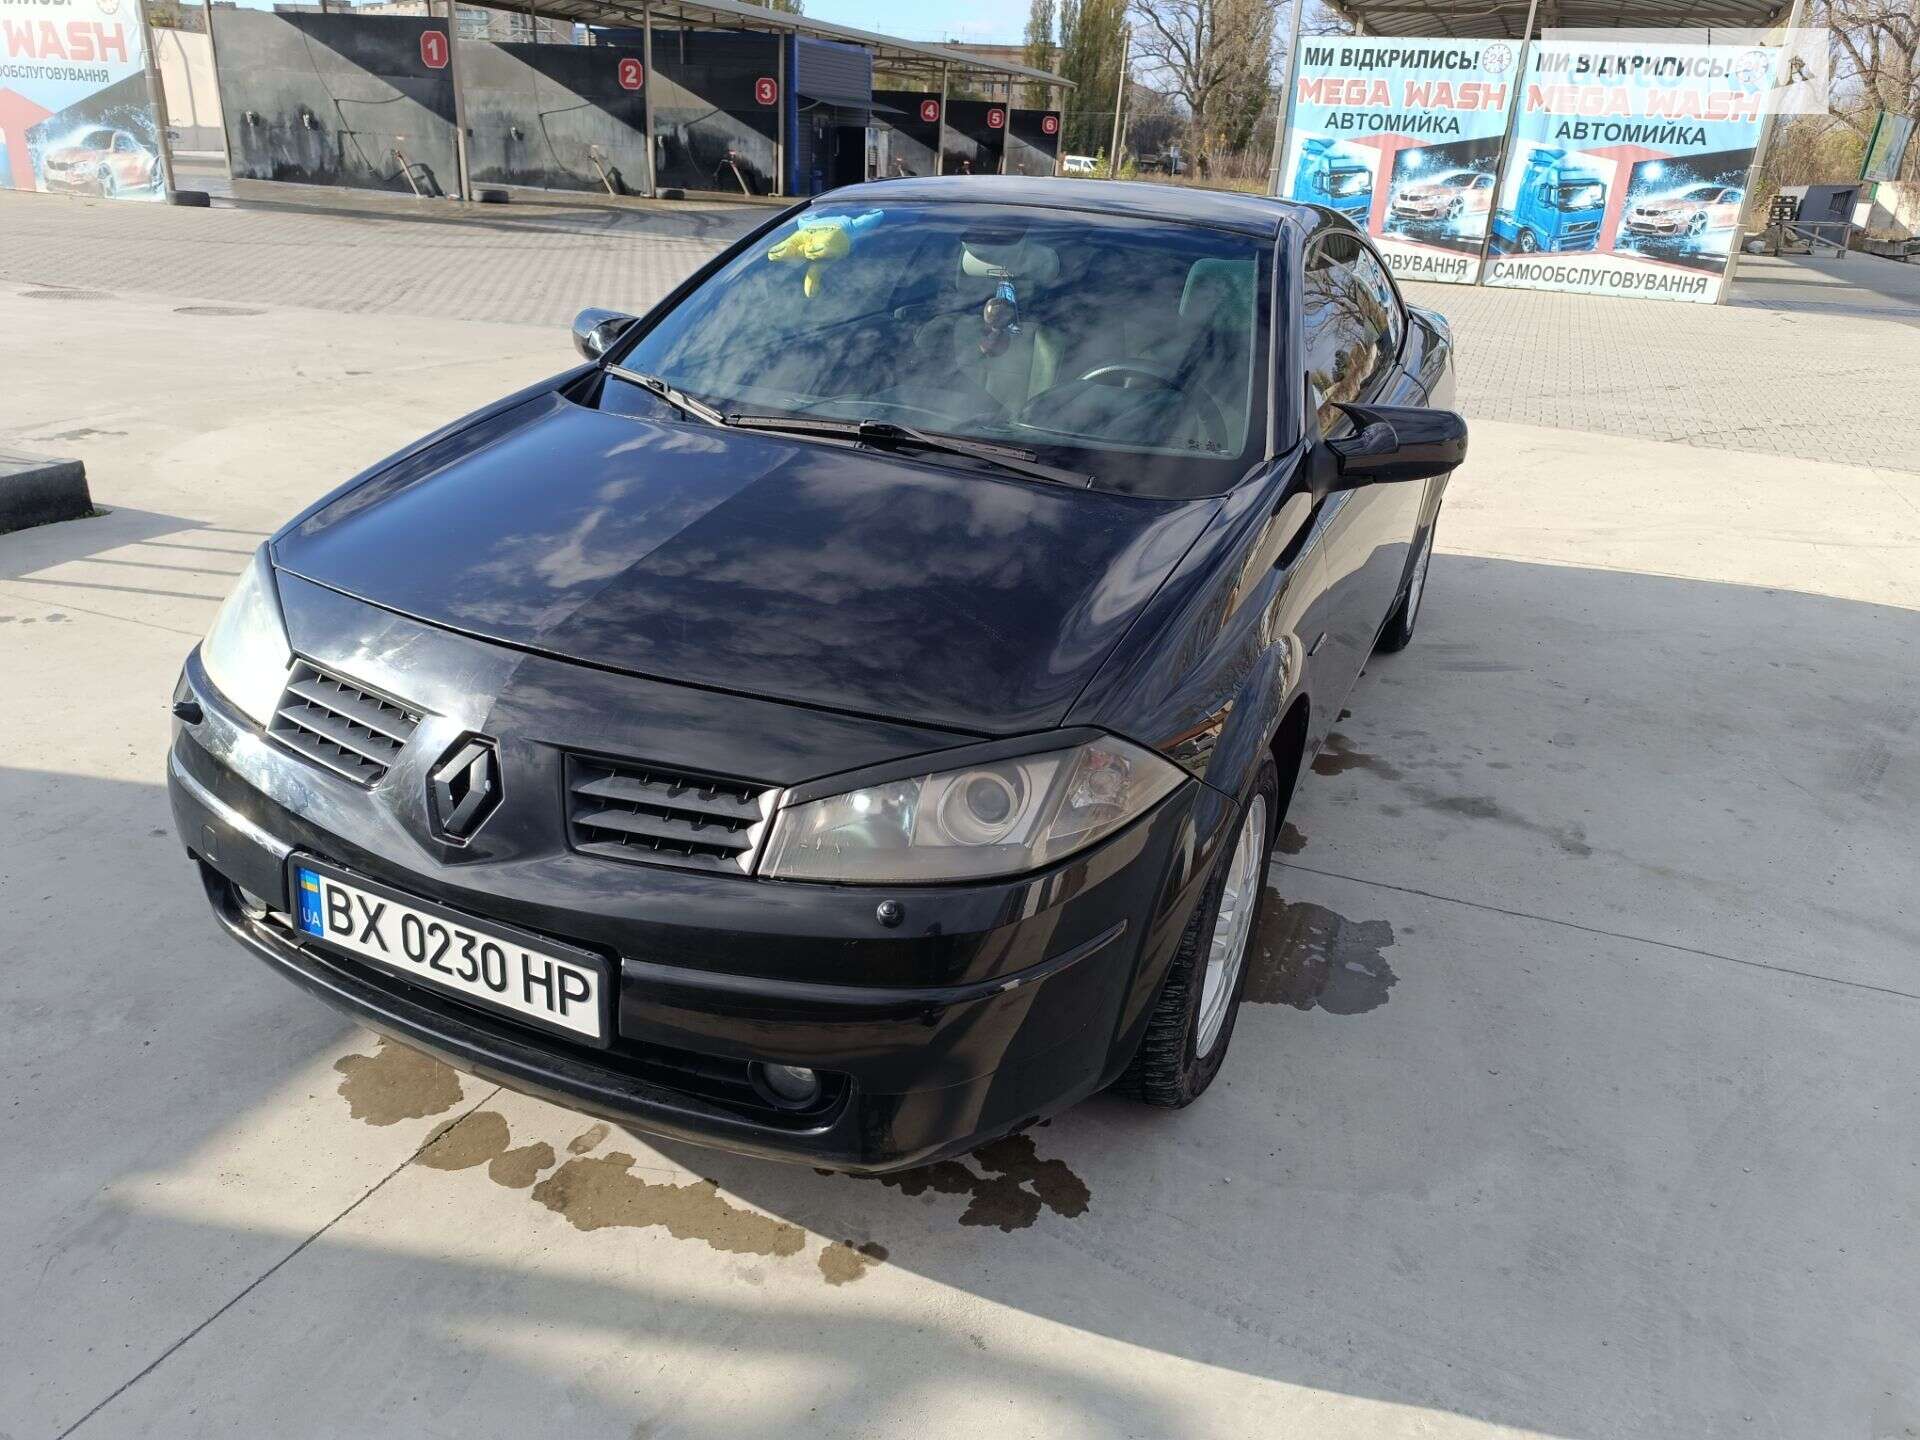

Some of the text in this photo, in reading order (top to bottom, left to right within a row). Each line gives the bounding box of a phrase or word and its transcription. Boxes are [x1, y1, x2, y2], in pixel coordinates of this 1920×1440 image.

[3, 19, 128, 62] WASH
[427, 38, 439, 61] 1
[1304, 47, 1479, 71] МИ ВІДКРИЛИСЬ!
[1489, 53, 1504, 65] 24
[1536, 53, 1569, 73] МИ
[1576, 54, 1733, 78] ВІДКРИЛИСЬ!
[0, 64, 110, 82] ОБСЛУГОВУВАННЯ
[625, 65, 637, 83] 2
[761, 84, 772, 99] 3
[1299, 78, 1507, 110] MEGA WASH
[924, 104, 936, 118] 4
[1527, 85, 1760, 122] MEGA WASH
[991, 112, 1001, 125] 5
[1045, 119, 1055, 130] 6
[1325, 111, 1460, 134] АВТОМИЙКА
[1555, 121, 1707, 145] АВТОМИЙКА
[1493, 262, 1708, 294] САМООБСЛУГОВУВАННЯ
[303, 910, 321, 928] UA
[326, 883, 591, 1016] BX 0230 HP
